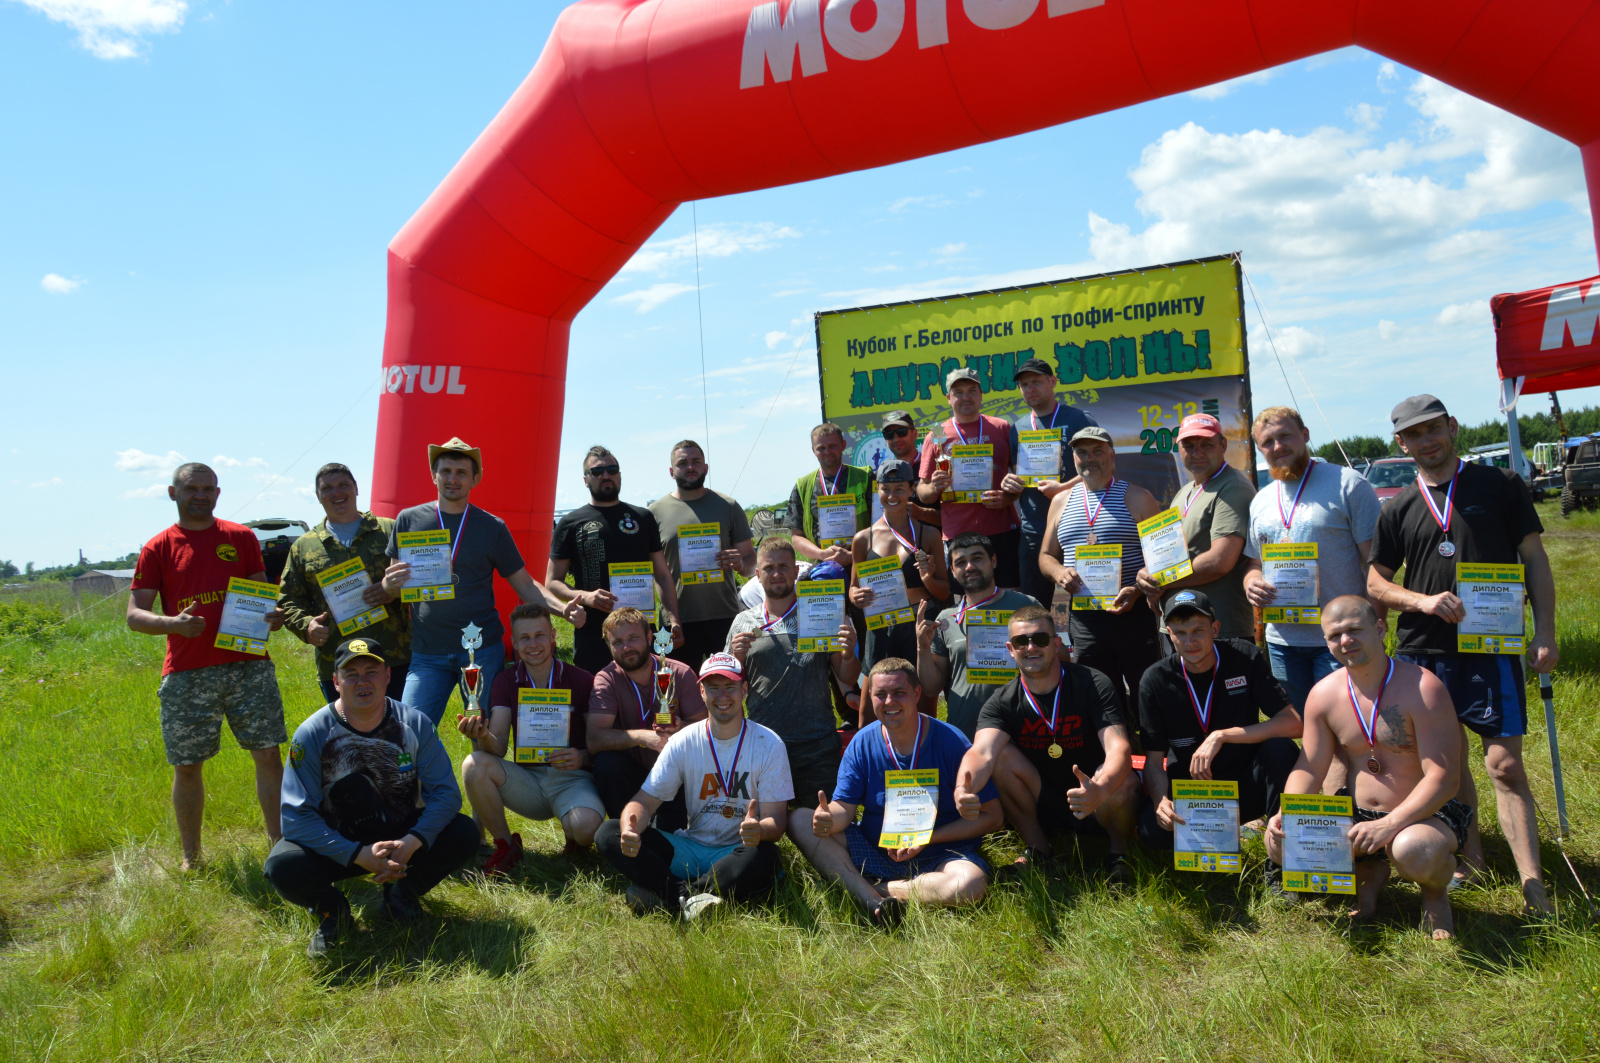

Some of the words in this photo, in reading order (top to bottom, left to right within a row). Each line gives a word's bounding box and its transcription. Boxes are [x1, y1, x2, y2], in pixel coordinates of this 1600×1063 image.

[740, 0, 1106, 89] MOT
[847, 336, 897, 359] Кубок
[904, 320, 1013, 350] г.Белогорск
[1022, 317, 1044, 334] по
[1052, 296, 1205, 332] трофи-спринту
[867, 573, 893, 584] ДИПЛОМ
[1472, 585, 1509, 593] ДИПЛОМ
[195, 590, 228, 605] "ШАТ
[237, 598, 266, 609] ДИПЛОМ
[1226, 678, 1246, 687] NASA
[1188, 802, 1225, 810] ДИПЛОМ
[1297, 818, 1337, 827] ДИПЛОМ
